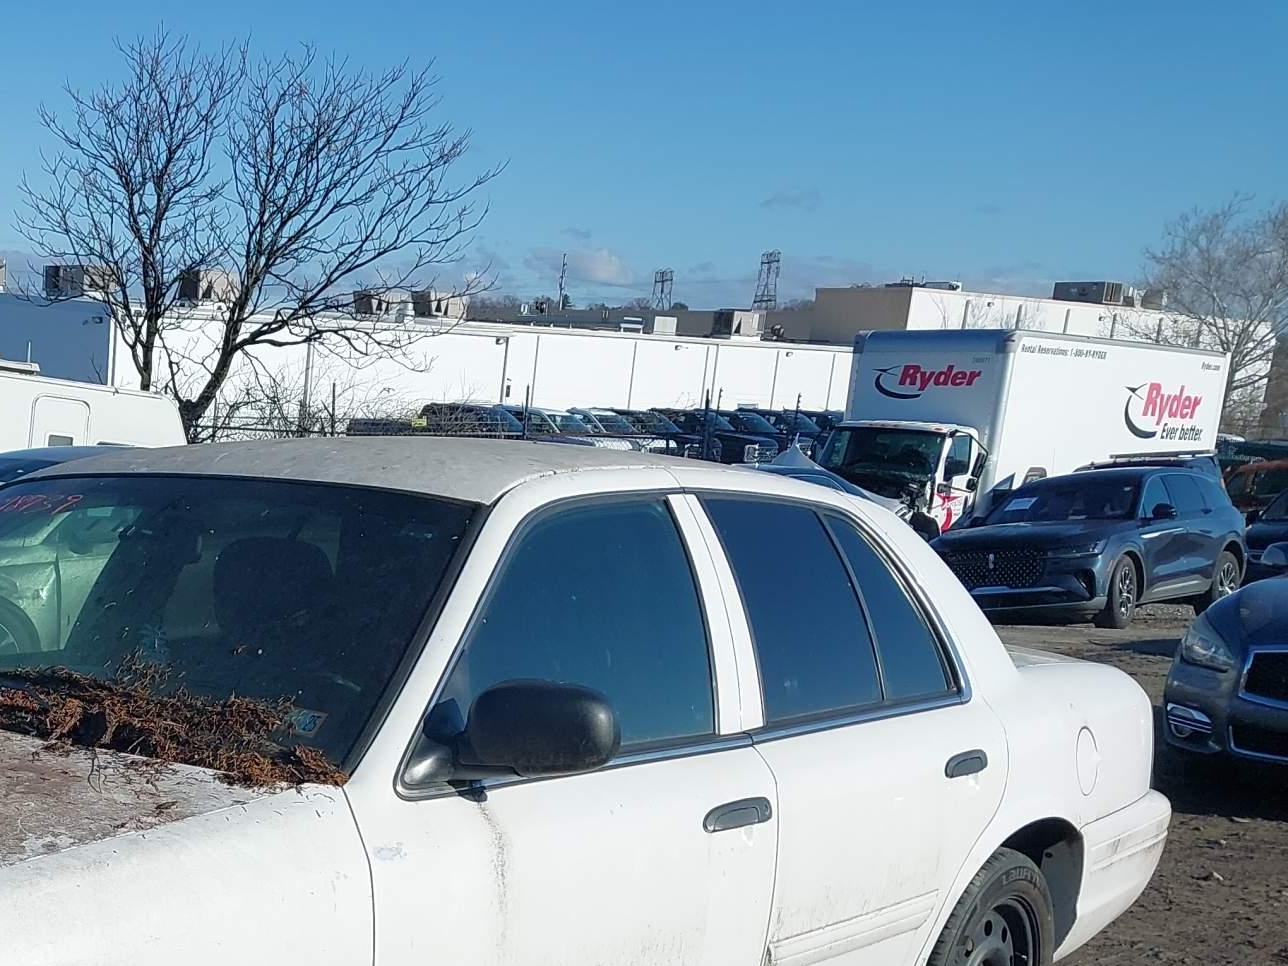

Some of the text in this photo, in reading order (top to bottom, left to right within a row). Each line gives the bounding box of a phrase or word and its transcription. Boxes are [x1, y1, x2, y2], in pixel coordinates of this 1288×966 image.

[898, 364, 982, 392] Ryder
[1142, 382, 1203, 426] Ryder
[1160, 422, 1180, 440] Ever
